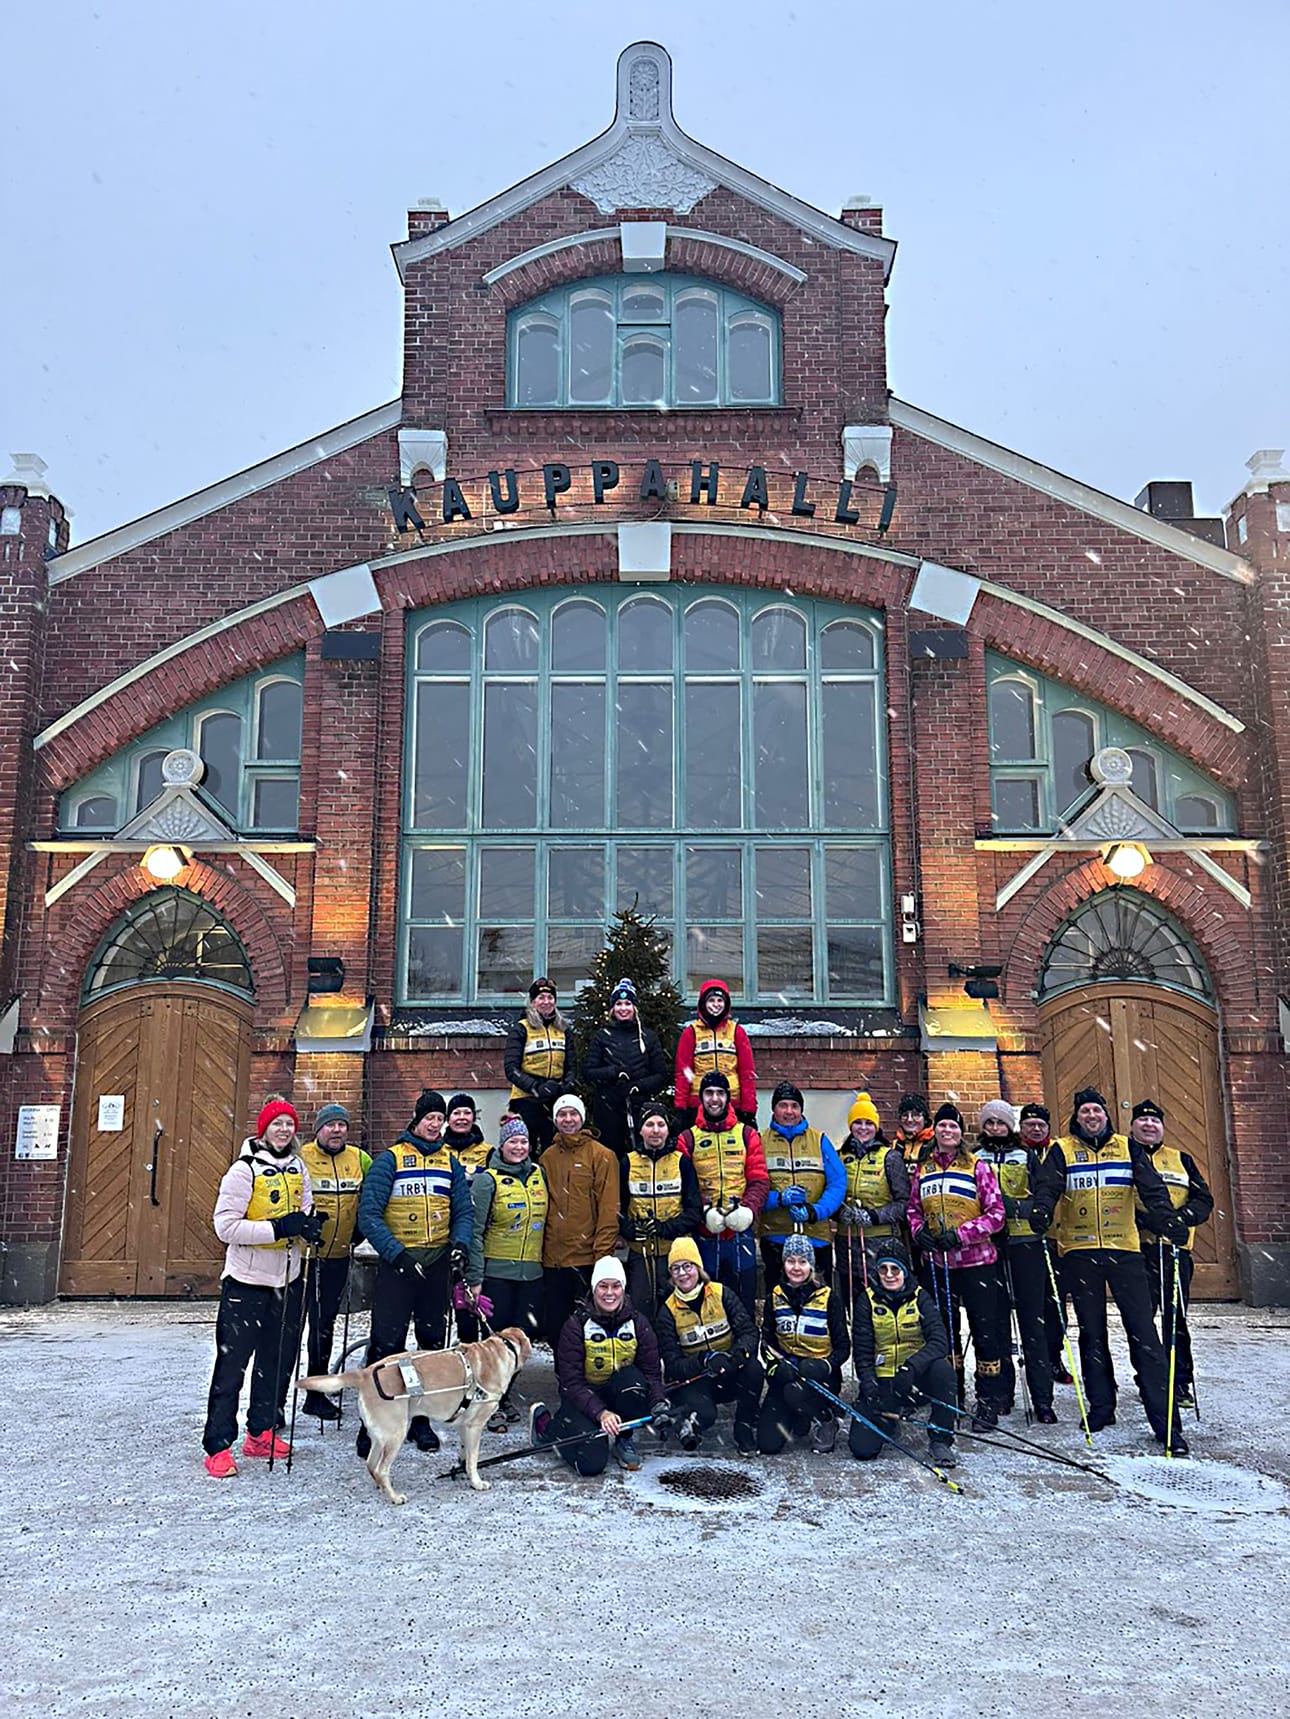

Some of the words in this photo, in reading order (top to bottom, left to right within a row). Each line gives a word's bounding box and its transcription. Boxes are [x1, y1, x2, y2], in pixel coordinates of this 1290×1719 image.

[388, 458, 897, 535] KAUPPAHALLI
[1073, 1176, 1098, 1189] TRBY
[400, 1183, 426, 1196] TRBY
